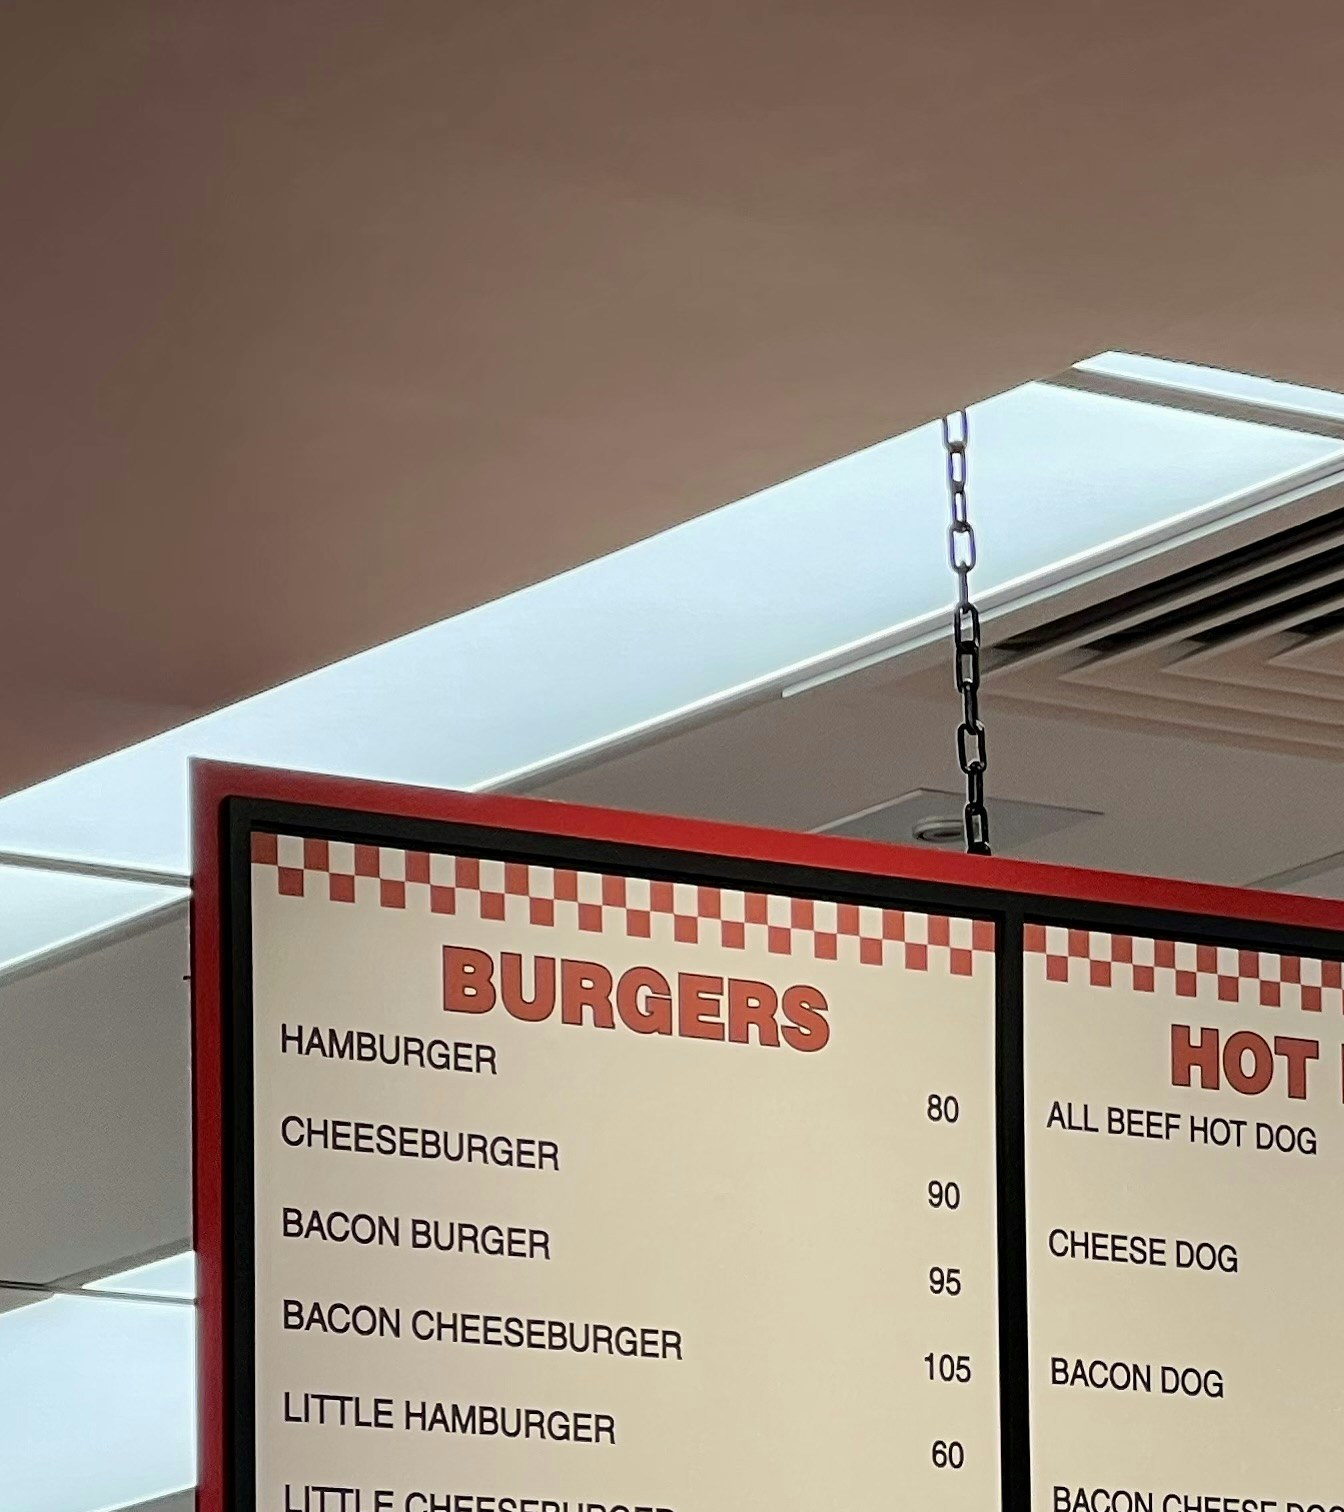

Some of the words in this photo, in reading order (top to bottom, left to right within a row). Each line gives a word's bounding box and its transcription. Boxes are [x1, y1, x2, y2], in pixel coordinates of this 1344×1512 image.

[443, 945, 830, 1052] BURGERS
[282, 1023, 497, 1074] HAMBURGER
[1171, 1024, 1319, 1100] HOT
[927, 1094, 959, 1123] 80
[1047, 1101, 1099, 1132] ALL
[1108, 1107, 1181, 1140] BEEF
[1190, 1116, 1247, 1147] HOT
[1256, 1123, 1316, 1155] DOG
[282, 1116, 559, 1171] CHEESEBURGER
[929, 1181, 960, 1209] 90
[1049, 1229, 1166, 1266] CHEESE
[1176, 1240, 1237, 1272] DOG
[284, 1300, 400, 1338] BACON
[412, 1310, 682, 1360] CHEESEBURGER
[925, 1353, 971, 1382] 105
